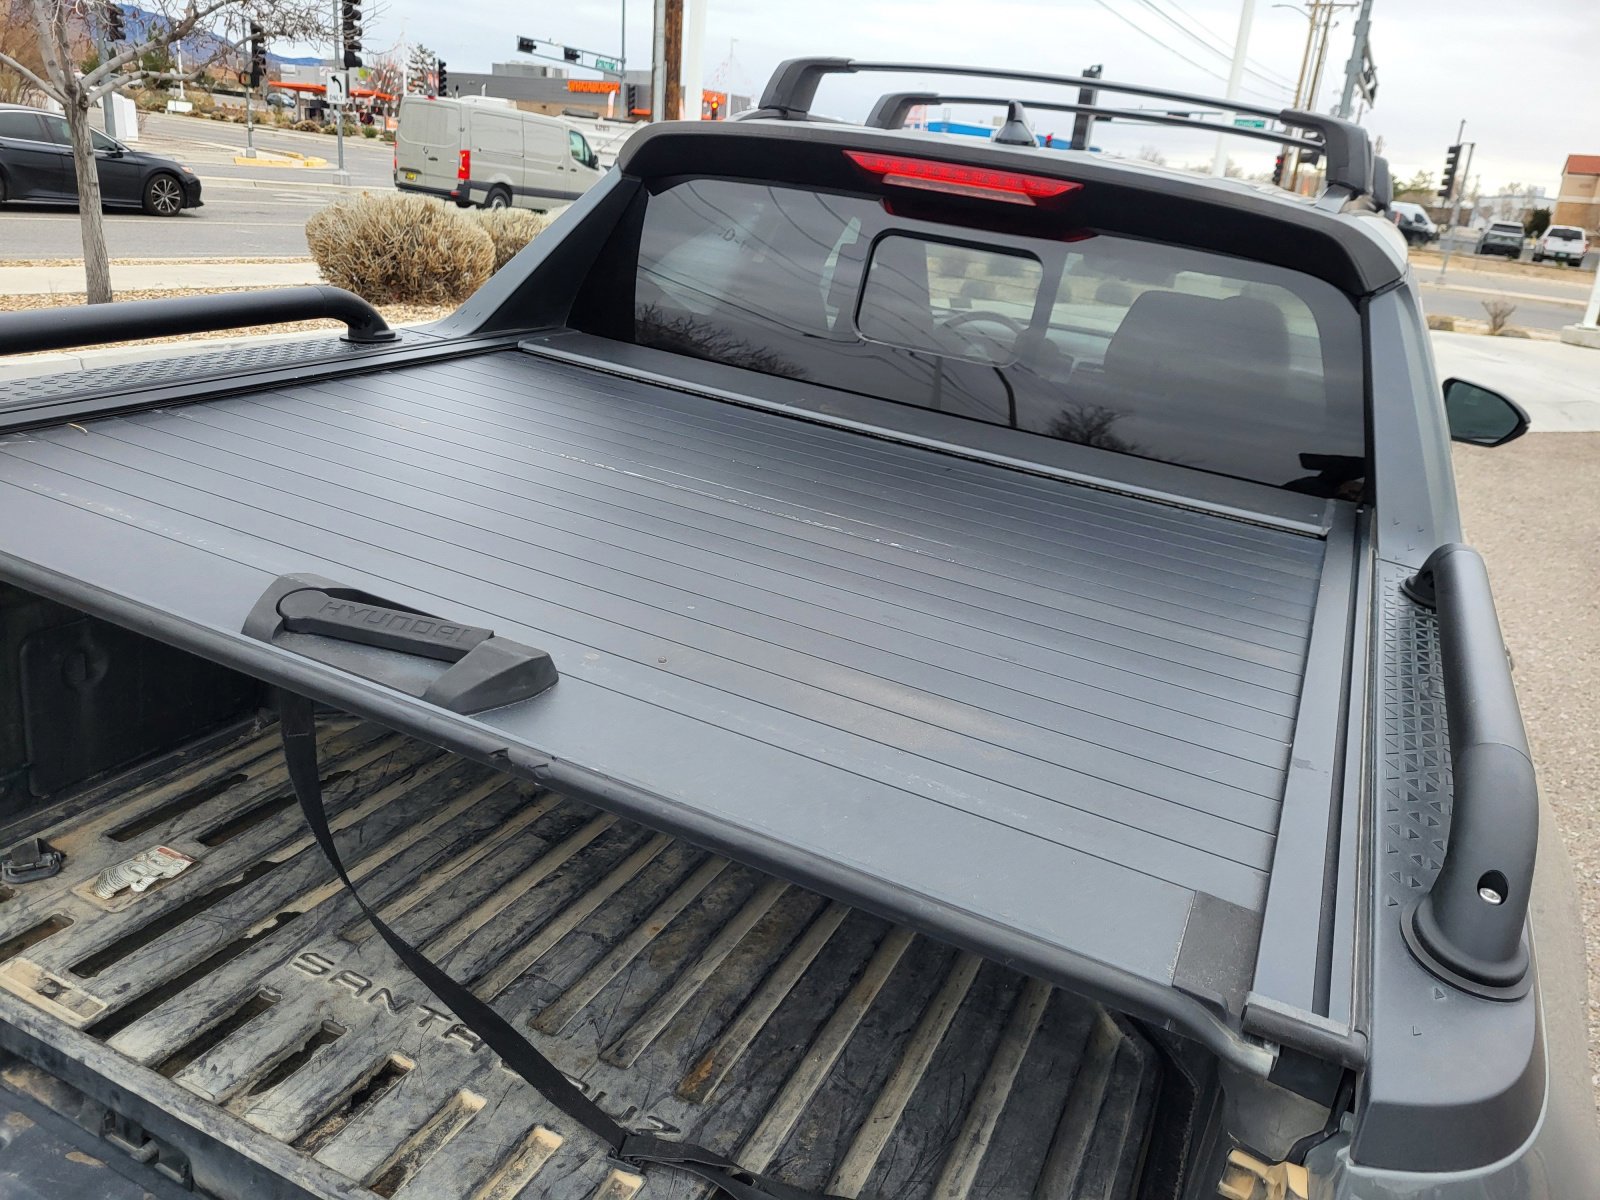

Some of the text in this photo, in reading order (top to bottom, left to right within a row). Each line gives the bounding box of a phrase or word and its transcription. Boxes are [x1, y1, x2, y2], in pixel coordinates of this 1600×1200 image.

[329, 93, 344, 101] ONLY
[318, 601, 471, 642] HYUNDAI
[292, 952, 486, 1054] SANTA
